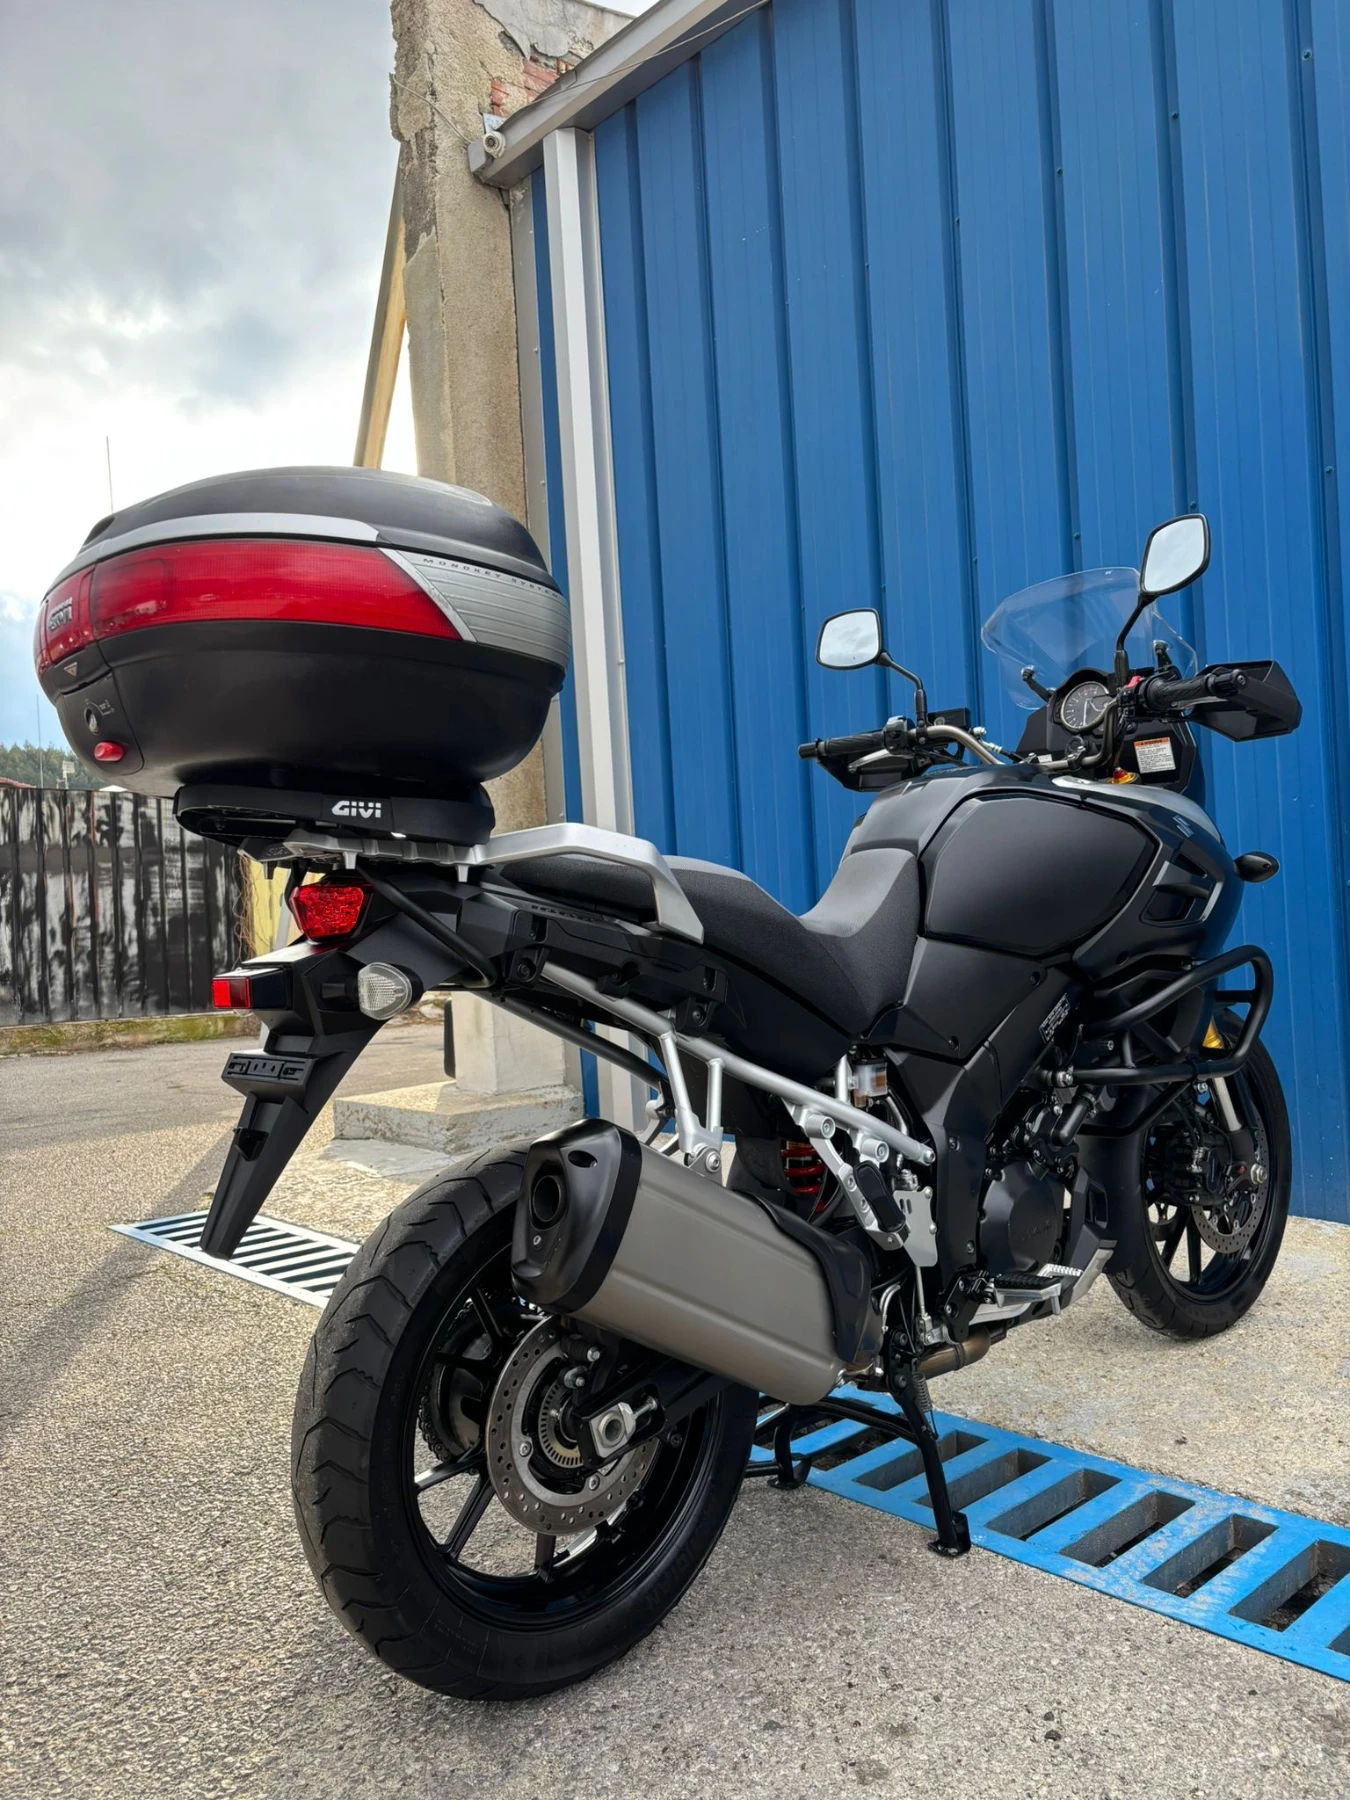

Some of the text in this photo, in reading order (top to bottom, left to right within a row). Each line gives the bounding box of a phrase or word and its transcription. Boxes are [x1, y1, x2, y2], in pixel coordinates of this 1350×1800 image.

[423, 558, 561, 598] MONOKEY SYSTEM
[331, 800, 382, 819] GIVI
